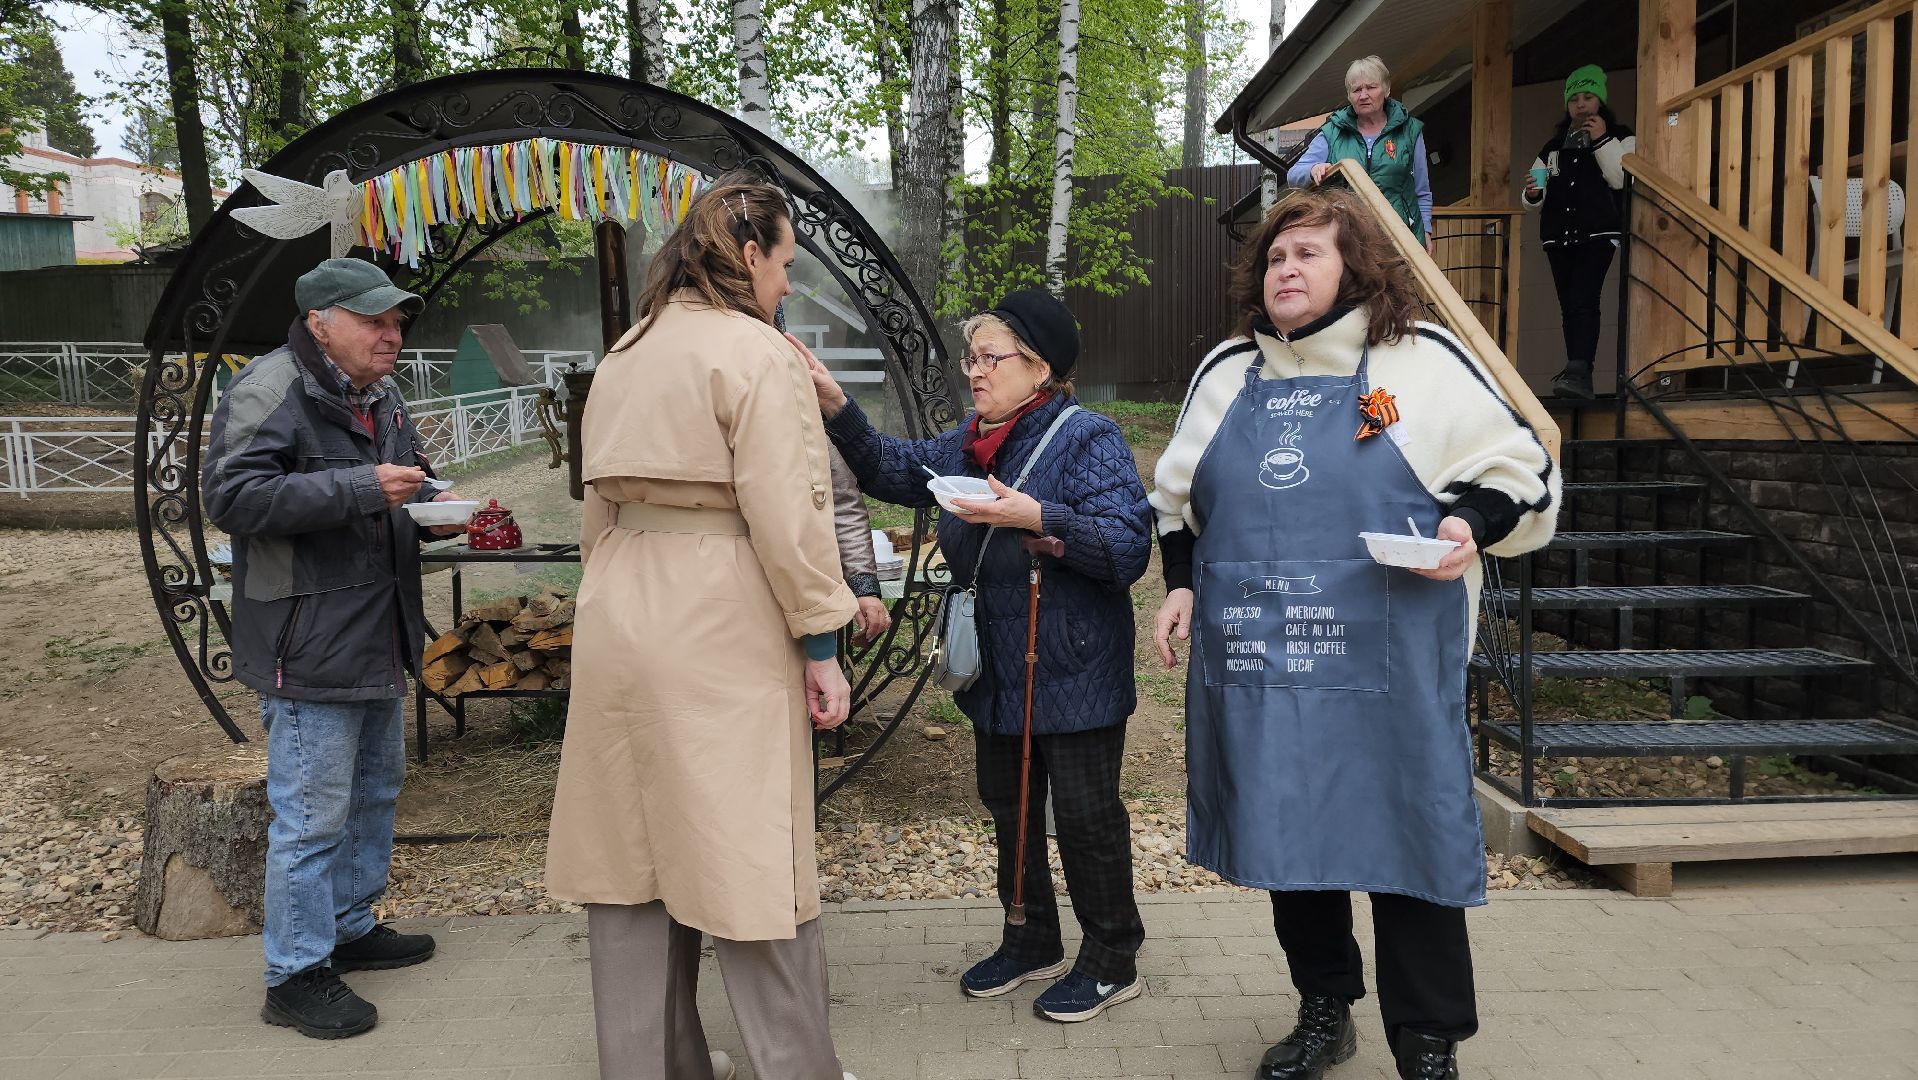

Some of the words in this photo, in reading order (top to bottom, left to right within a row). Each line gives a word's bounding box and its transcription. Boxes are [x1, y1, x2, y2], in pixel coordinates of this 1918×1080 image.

[1266, 389, 1322, 410] coffee
[1265, 580, 1290, 591] MENU
[1223, 606, 1262, 620] ESPRESSO
[1285, 605, 1335, 620] AMERICANO
[1285, 621, 1308, 636] CAFÉ
[1312, 623, 1323, 637] AU
[1326, 624, 1346, 637] LAIT
[1286, 641, 1310, 655] IRISH
[1313, 640, 1348, 655] COFFEE
[1287, 658, 1315, 673] DECAF
